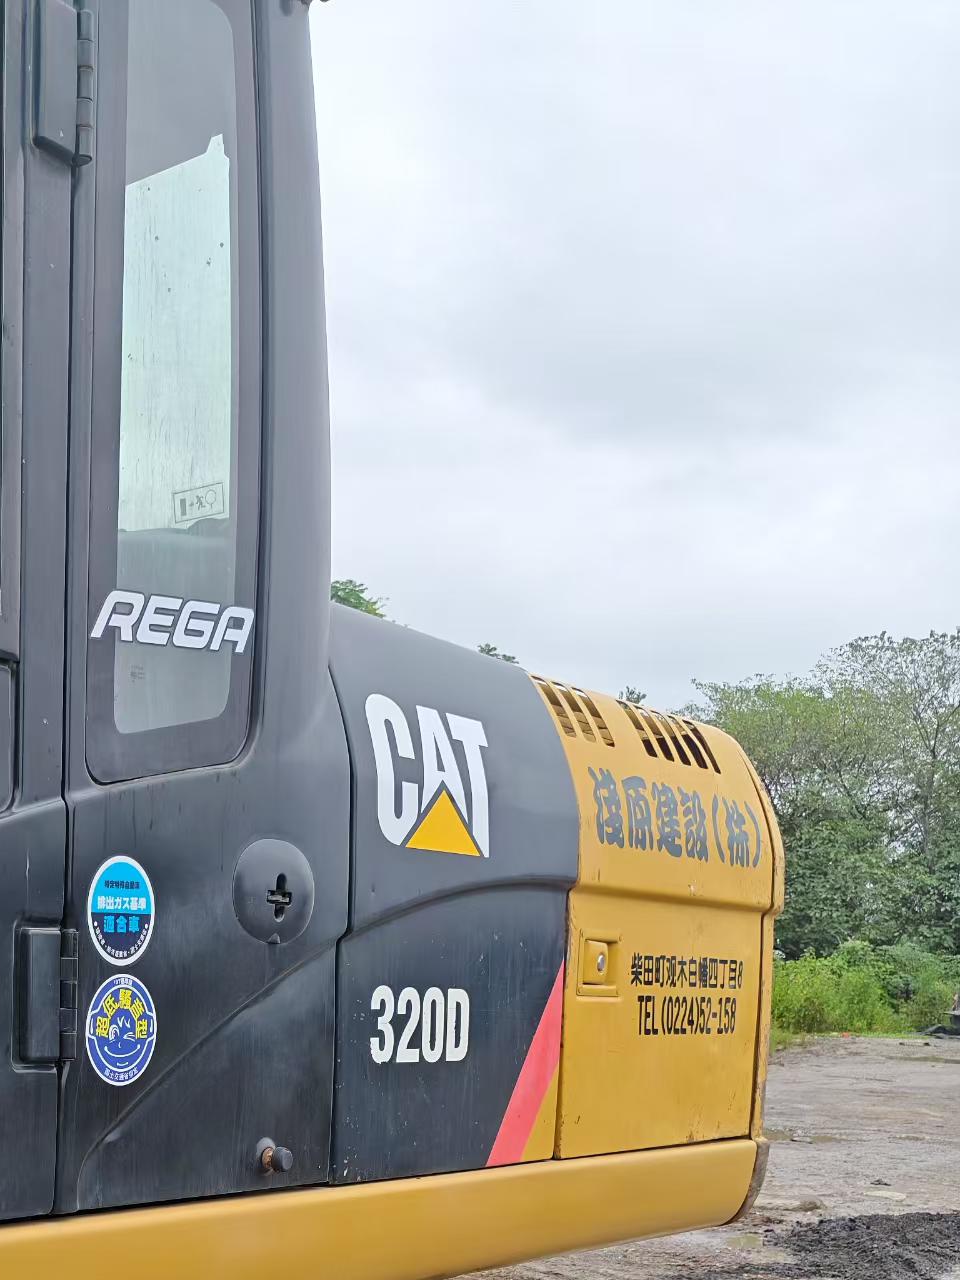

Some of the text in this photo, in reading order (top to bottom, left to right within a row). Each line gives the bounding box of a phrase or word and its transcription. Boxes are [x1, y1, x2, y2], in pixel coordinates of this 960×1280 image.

[90, 590, 255, 653] REGA
[365, 693, 490, 858] CAT
[103, 915, 140, 933] 適合車
[370, 984, 470, 1064] 320D
[637, 995, 659, 1035] TEL
